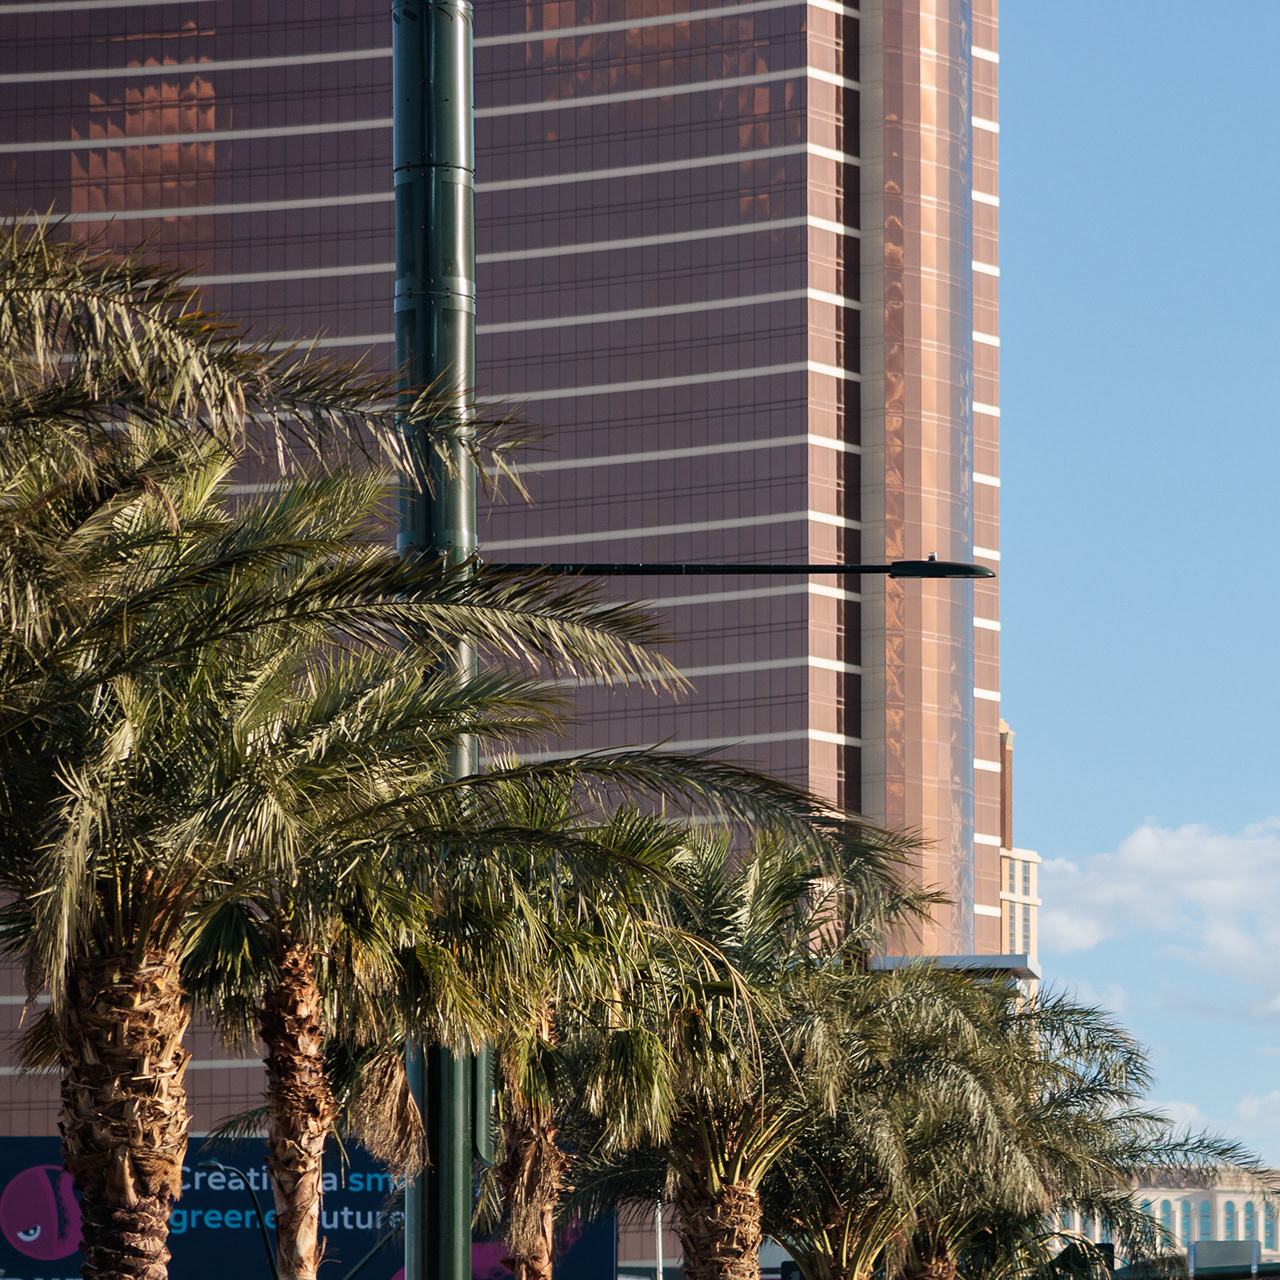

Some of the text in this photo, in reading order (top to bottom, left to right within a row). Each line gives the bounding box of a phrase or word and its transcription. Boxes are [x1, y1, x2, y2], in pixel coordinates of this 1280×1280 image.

[179, 1166, 269, 1192] Creati
[169, 1206, 405, 1234] greene uture
